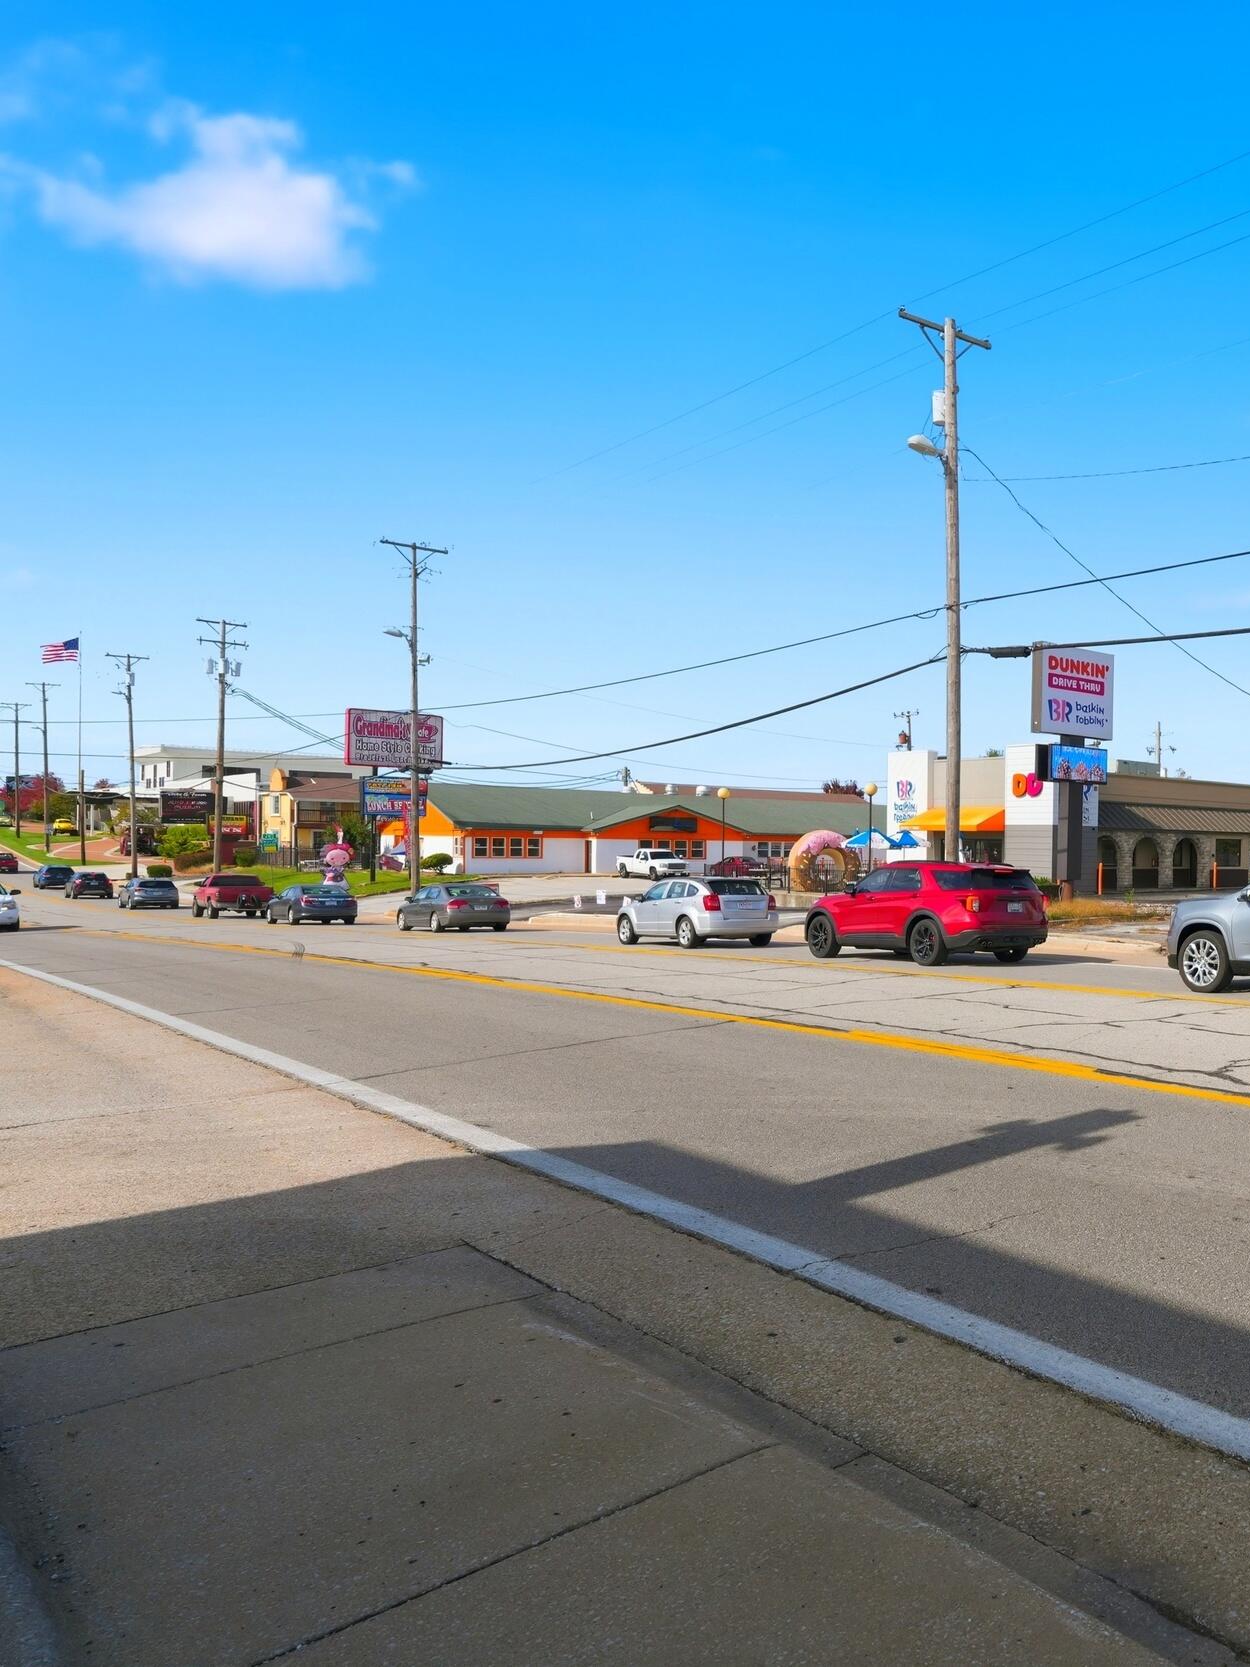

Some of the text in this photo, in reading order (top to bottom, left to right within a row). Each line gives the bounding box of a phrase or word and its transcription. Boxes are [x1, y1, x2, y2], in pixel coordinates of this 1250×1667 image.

[1048, 655, 1110, 679] DUNKIN'
[1052, 676, 1101, 693] DRIVE THRU
[1048, 698, 1073, 723] BR
[356, 739, 436, 757] Home Style Cking
[896, 779, 913, 798] BR
